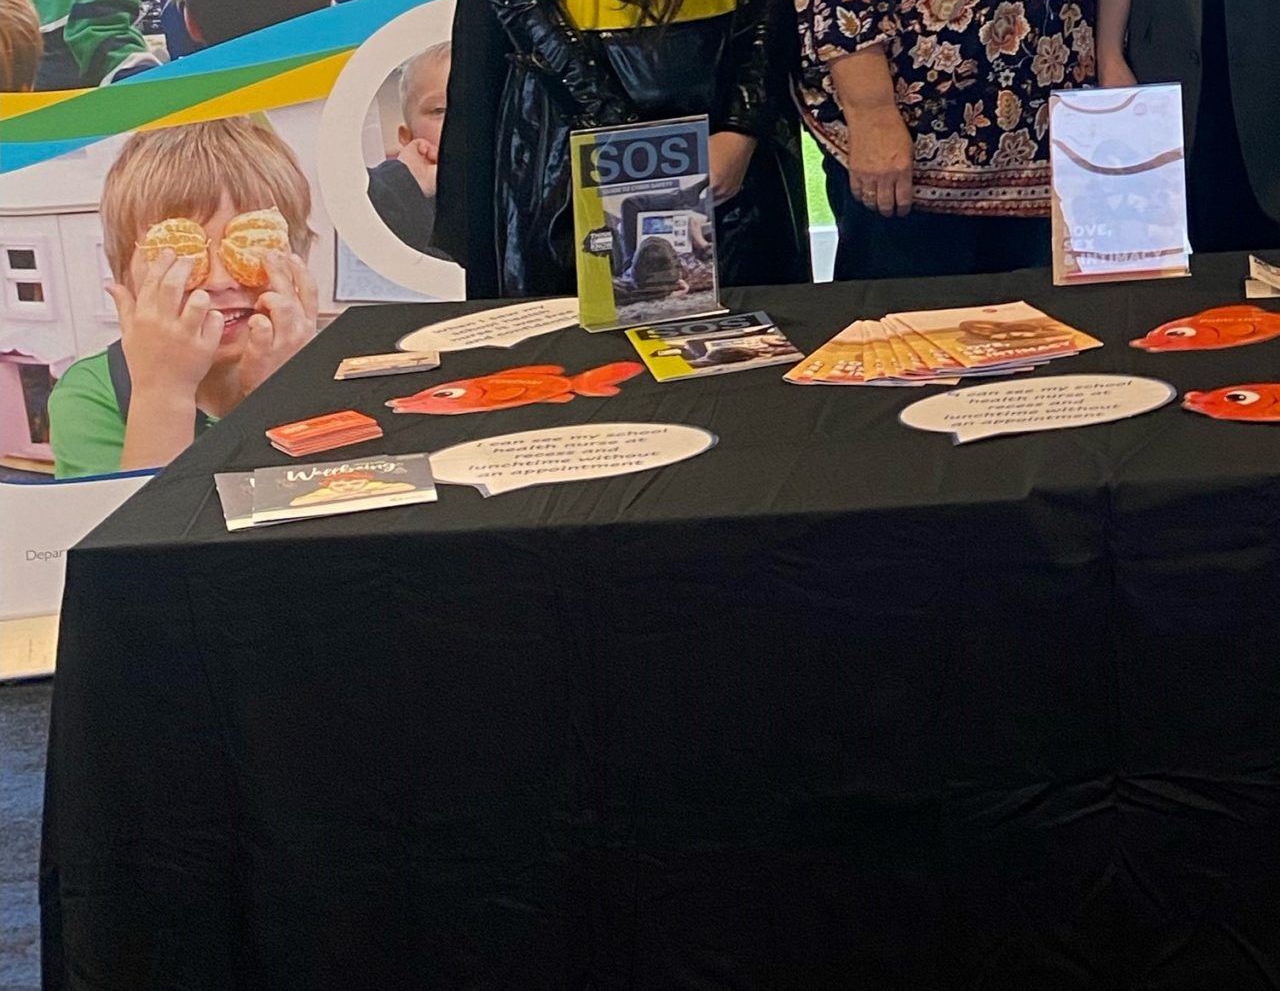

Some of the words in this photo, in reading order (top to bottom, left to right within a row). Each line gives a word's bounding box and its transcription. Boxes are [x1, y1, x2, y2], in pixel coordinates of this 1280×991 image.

[589, 136, 691, 184] SOS
[647, 316, 750, 339] SOS
[1074, 381, 1132, 389] school
[968, 395, 1027, 404] health
[943, 408, 1039, 419] lunchtime
[1045, 404, 1121, 413] without
[980, 412, 1105, 424] appointment
[605, 428, 667, 437] school
[493, 443, 556, 453] health
[564, 440, 618, 448] nurse
[514, 450, 575, 459] recess
[581, 446, 619, 454] and
[468, 457, 571, 470] lunchtime
[577, 450, 659, 461] without
[510, 460, 645, 475] appointment
[26, 550, 67, 562] Depar
